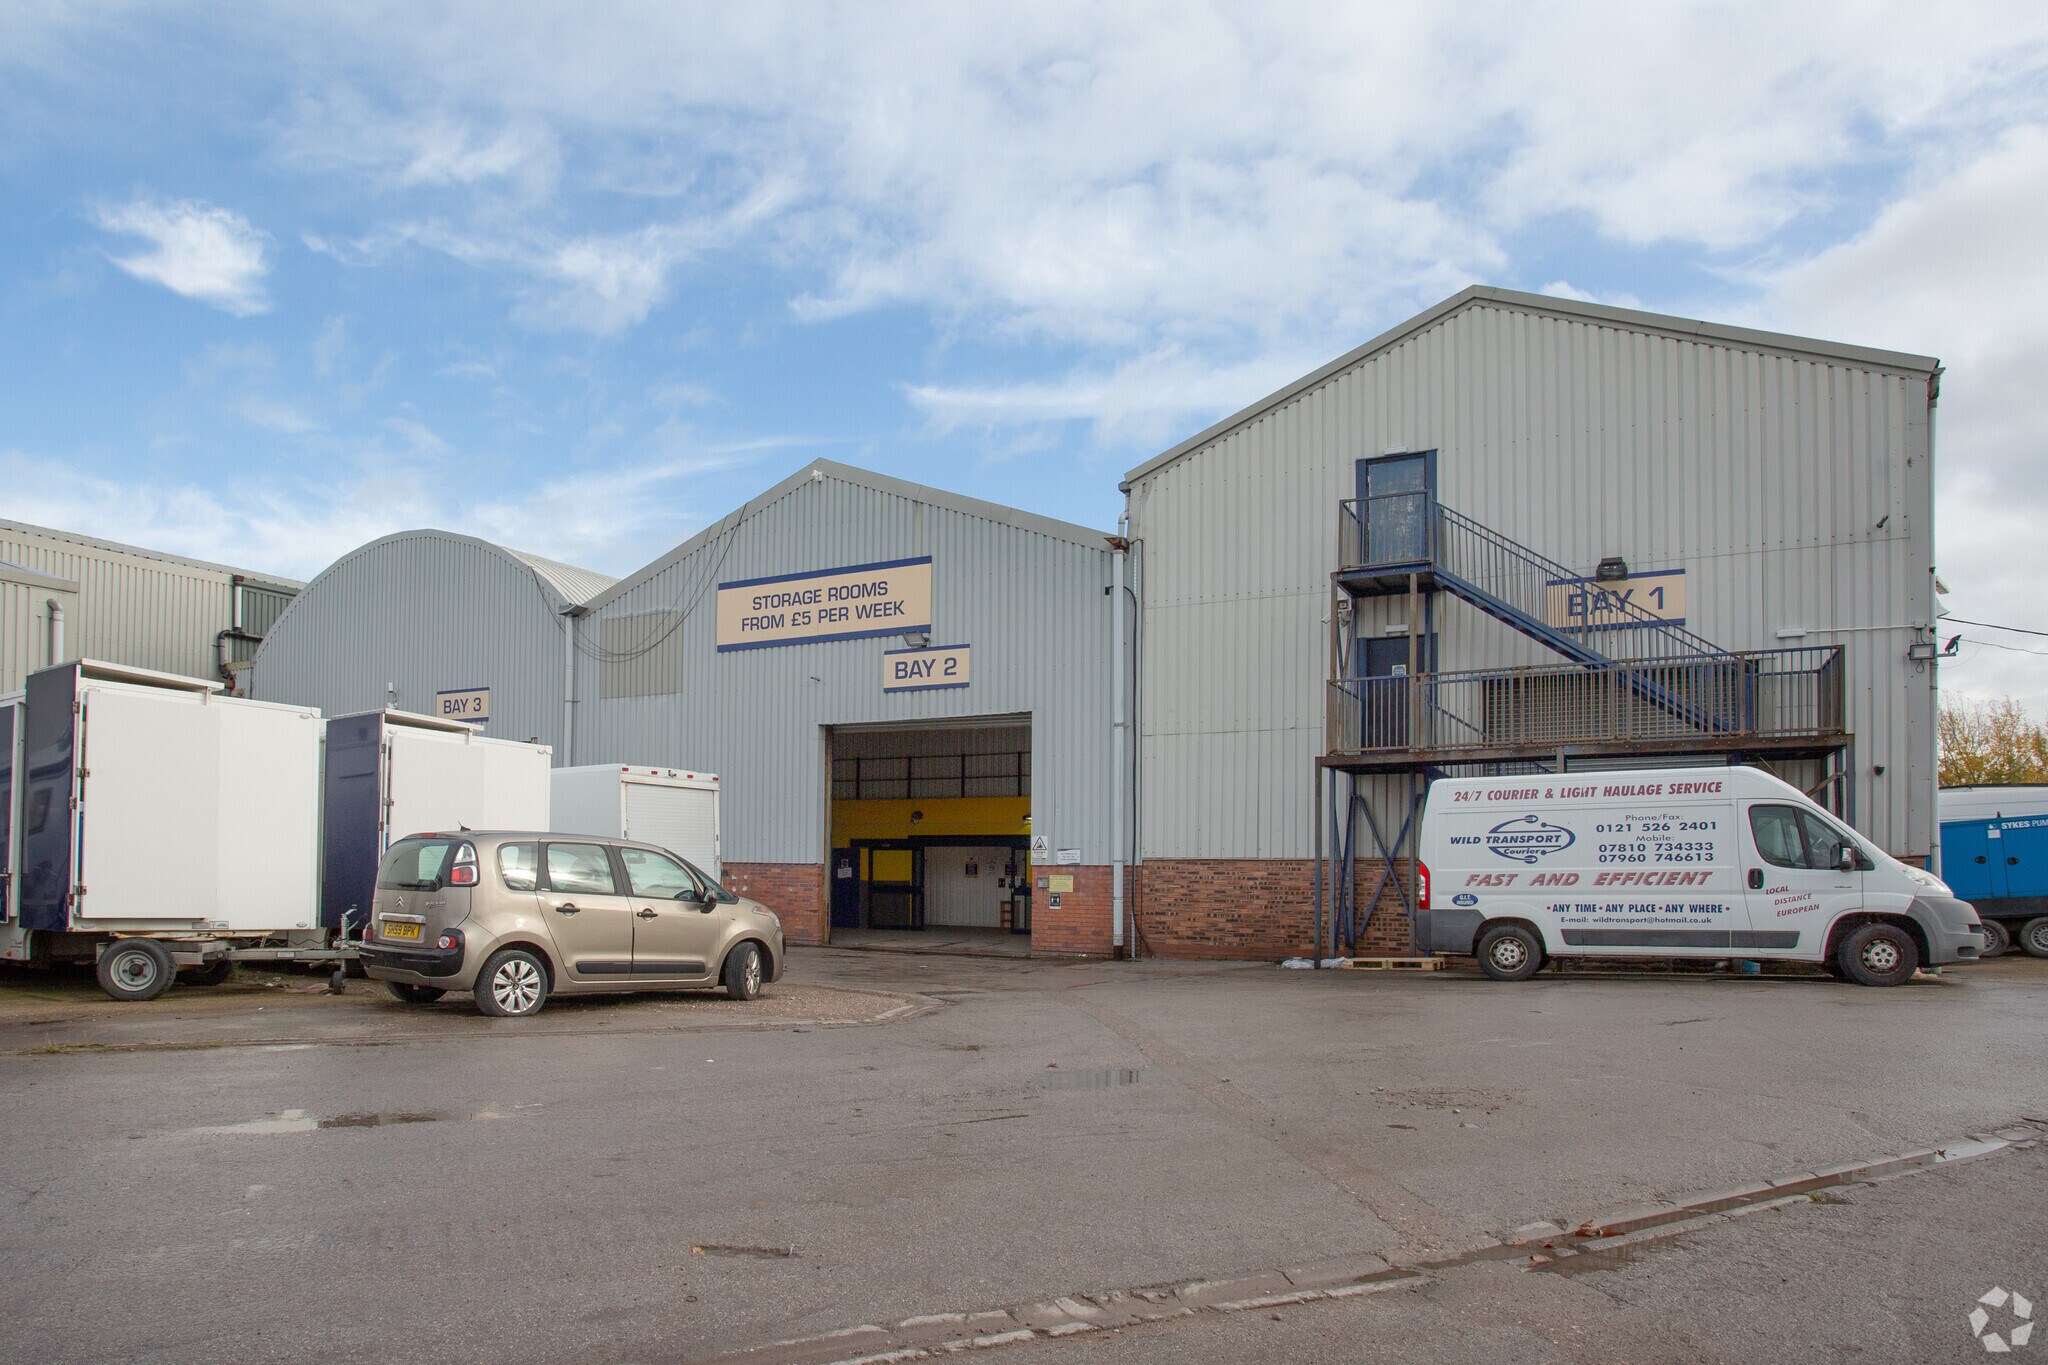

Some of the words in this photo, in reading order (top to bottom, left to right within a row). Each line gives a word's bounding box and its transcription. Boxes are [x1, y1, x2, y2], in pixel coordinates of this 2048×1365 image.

[752, 589, 822, 611] STORAGE
[828, 581, 889, 602] ROOMS
[1568, 588, 1635, 616] BAY
[1648, 586, 1664, 609] 1
[741, 613, 785, 632] FROM
[791, 611, 811, 627] £5
[818, 607, 849, 623] PER
[855, 600, 905, 620] WEEK
[895, 658, 936, 680] BAY
[943, 657, 958, 676] 2
[443, 698, 469, 714] BAY
[473, 697, 482, 712] 3
[1453, 790, 1482, 802] 24/7
[1487, 788, 1539, 801] COURIER
[1544, 788, 1554, 799] &
[1560, 786, 1597, 799] LIGHT
[1603, 784, 1663, 797] HAULAGE
[1668, 781, 1722, 795] SERVICE
[1625, 813, 1684, 822] Phone/Fax:
[1596, 823, 1632, 833] 0121
[1641, 822, 1671, 832] 526
[1679, 821, 1717, 831] 2401
[2001, 820, 2031, 830] SYKES
[1450, 836, 1481, 845] WILD
[1486, 834, 1562, 844] TRANSPORT
[1635, 834, 1675, 842] Mobile:
[1503, 847, 1541, 855] Courier
[1598, 843, 1646, 853] 07810
[1654, 842, 1714, 852] 734333
[1598, 853, 1646, 863] 07960
[1654, 852, 1714, 862] 746613
[1464, 873, 1519, 887] FAST
[1528, 872, 1580, 887] AND
[1593, 871, 1713, 886] EFFICIENT
[1765, 885, 1790, 895] LOCAL
[1774, 893, 1812, 906] DISTANCE
[1552, 904, 1571, 913] ANY
[1575, 904, 1597, 913] TIME
[1605, 904, 1624, 913] ANY
[1628, 904, 1656, 913] PLACE
[1665, 904, 1684, 913] ANY
[1689, 904, 1723, 913] WHERE
[1777, 904, 1820, 917] EUROPEAN
[1592, 916, 1712, 925] wildtransport@hotmail.co.uk
